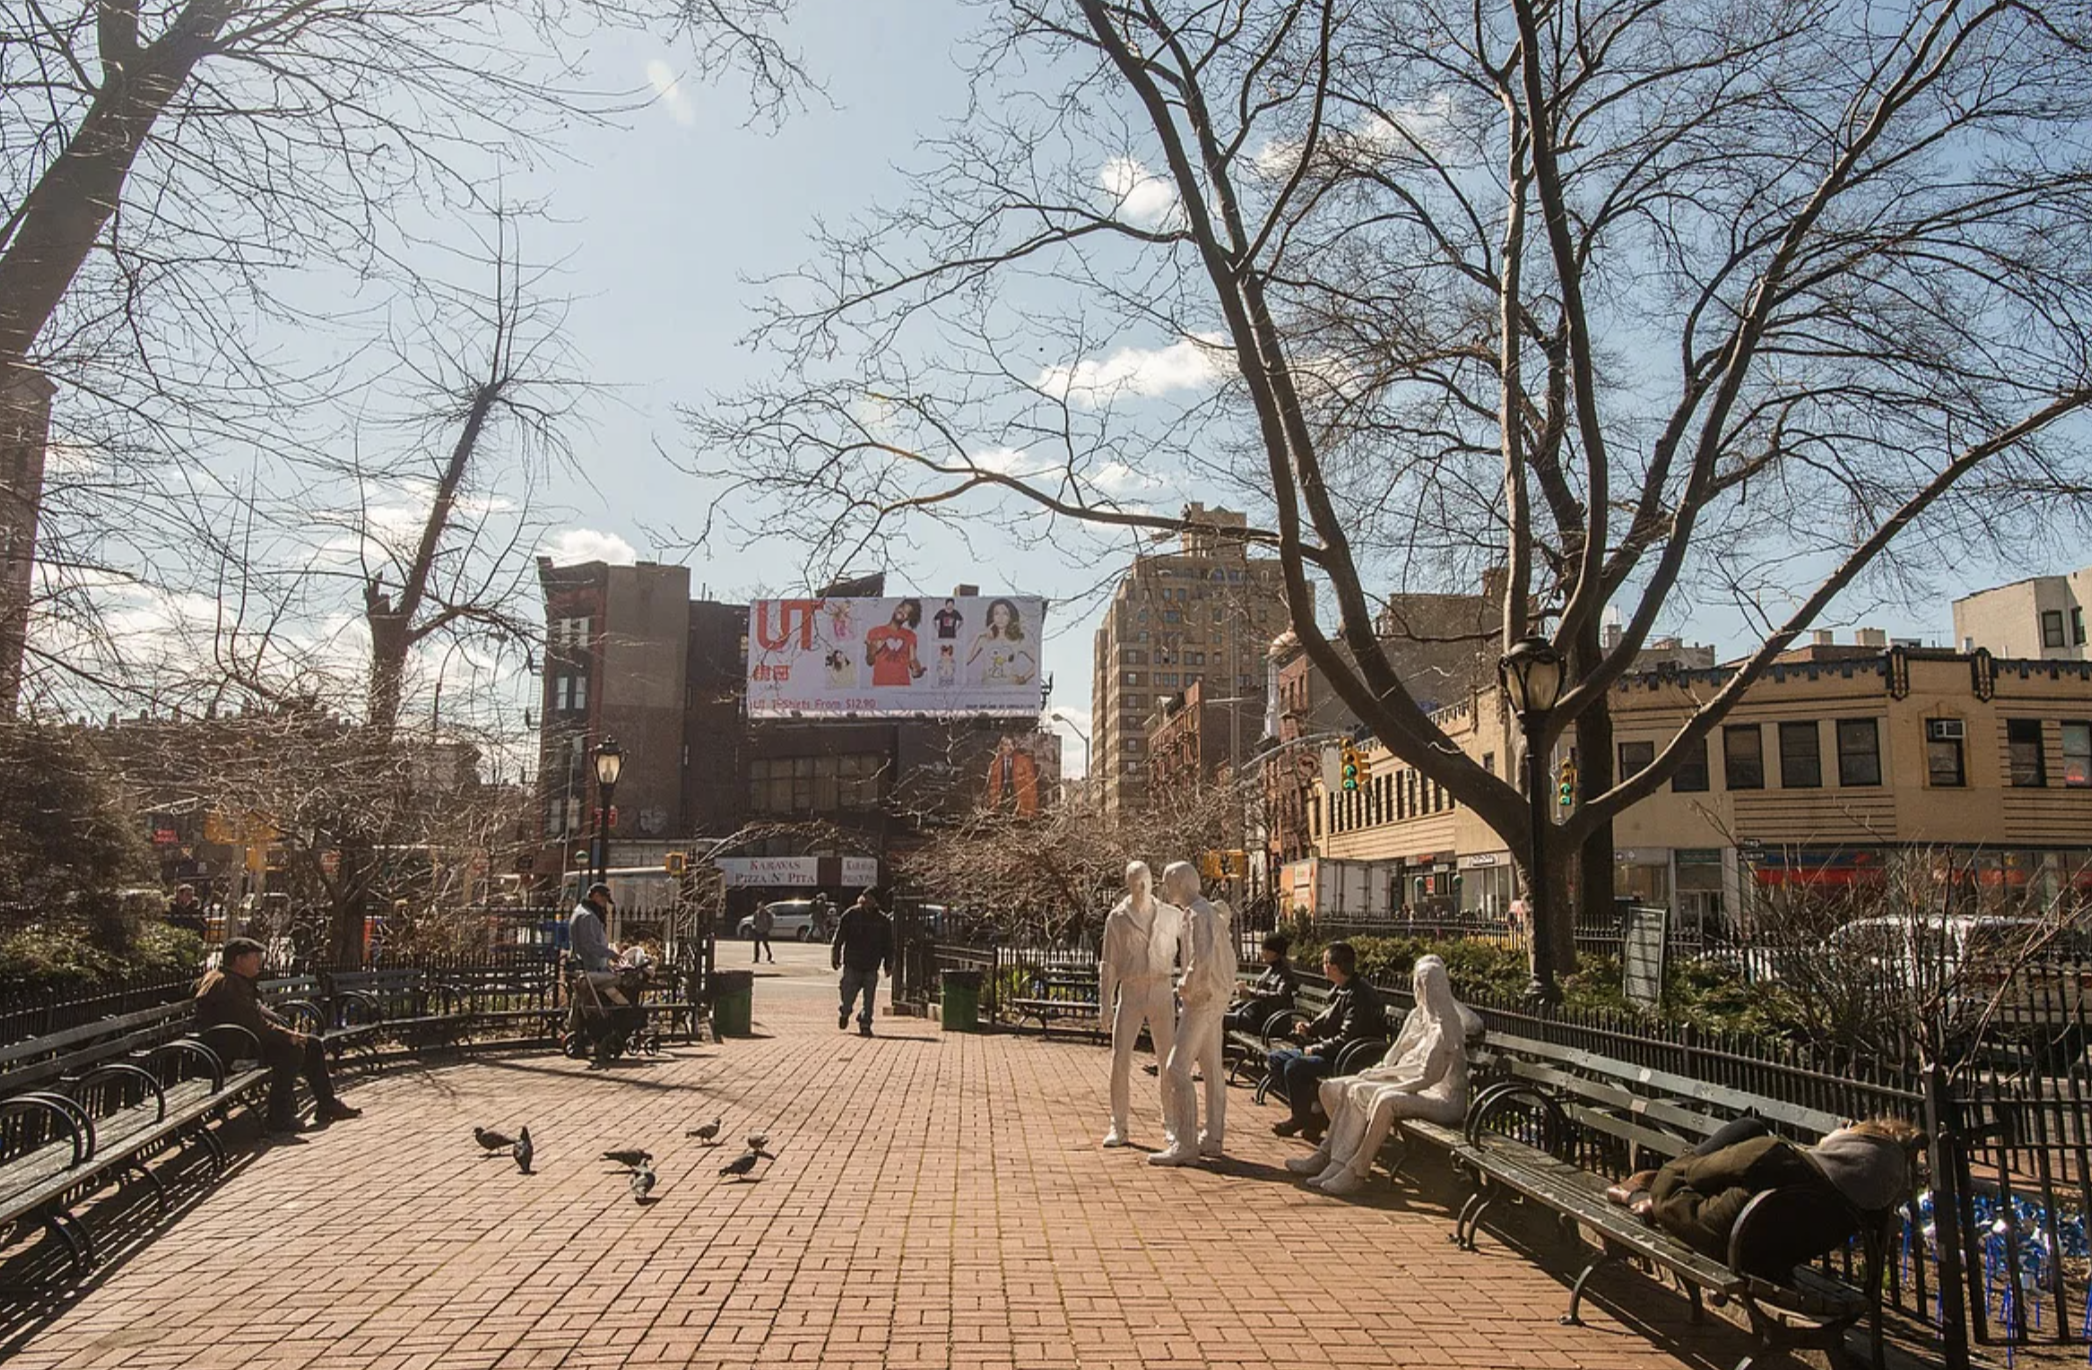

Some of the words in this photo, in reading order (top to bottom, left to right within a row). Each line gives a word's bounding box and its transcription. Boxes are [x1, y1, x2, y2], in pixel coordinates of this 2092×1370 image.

[757, 600, 823, 651] UT
[816, 699, 841, 709] From
[846, 698, 877, 709] $12.90
[735, 873, 767, 884] PIZZA
[789, 872, 816, 883] PITA
